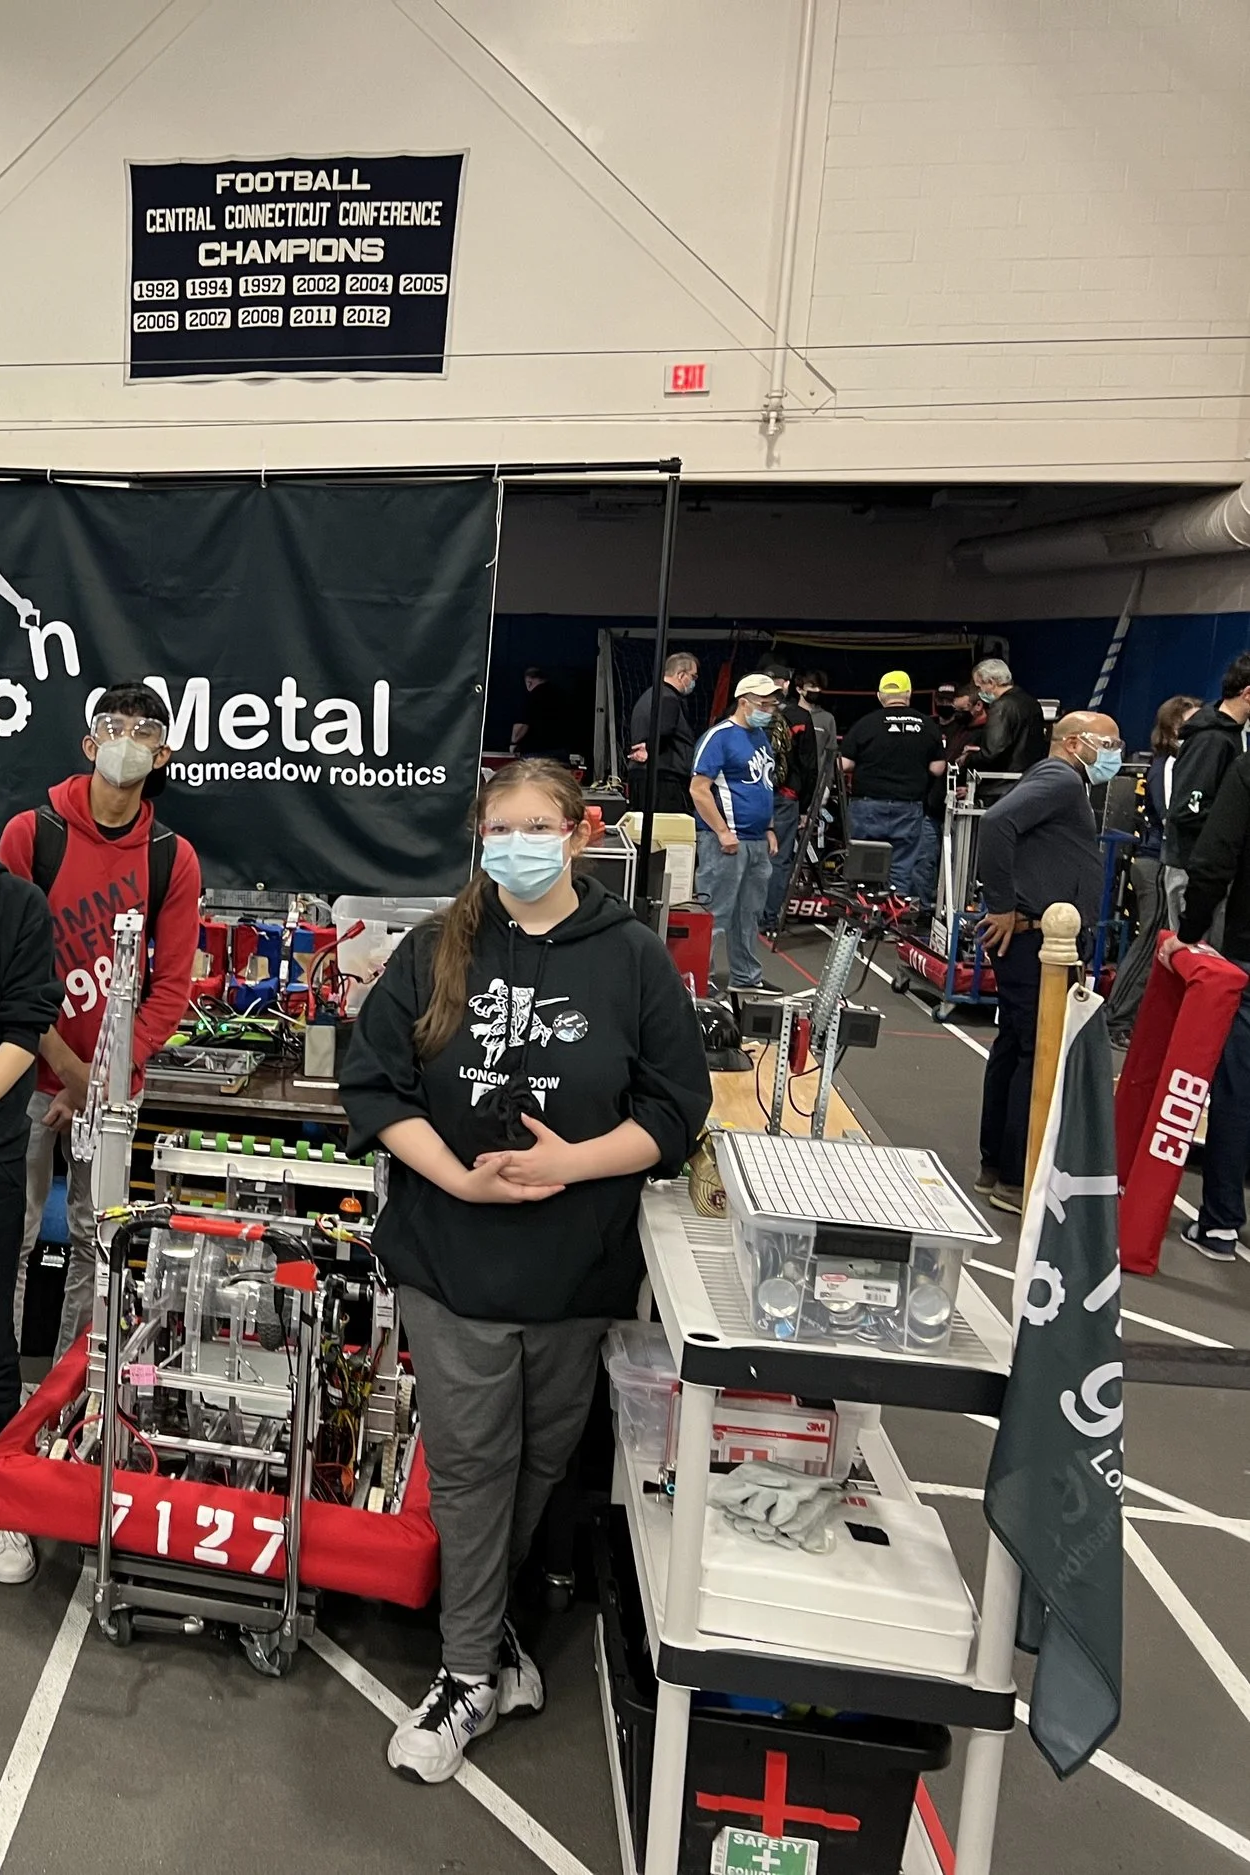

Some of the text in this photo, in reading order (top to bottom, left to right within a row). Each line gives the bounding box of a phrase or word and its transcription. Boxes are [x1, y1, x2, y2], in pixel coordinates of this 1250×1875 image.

[216, 169, 371, 194] FOOTBALL
[146, 201, 443, 233] CENTRAL CONNECTICUT CONFERENCE
[198, 237, 385, 267] CHAMPIONS
[137, 276, 444, 299] 1992 1994 1997 2002 2004 2005
[137, 308, 387, 330] 2006 2007 2008 2011 2012
[329, 762, 447, 787] robotics
[51, 871, 144, 944] OMMY
[61, 956, 112, 1019] 198
[459, 1065, 560, 1090] LONGMDOW
[1149, 1068, 1209, 1167] 8013
[806, 1422, 825, 1433] 3M
[112, 1492, 285, 1574] 7127
[732, 1833, 804, 1854] SAFETY
